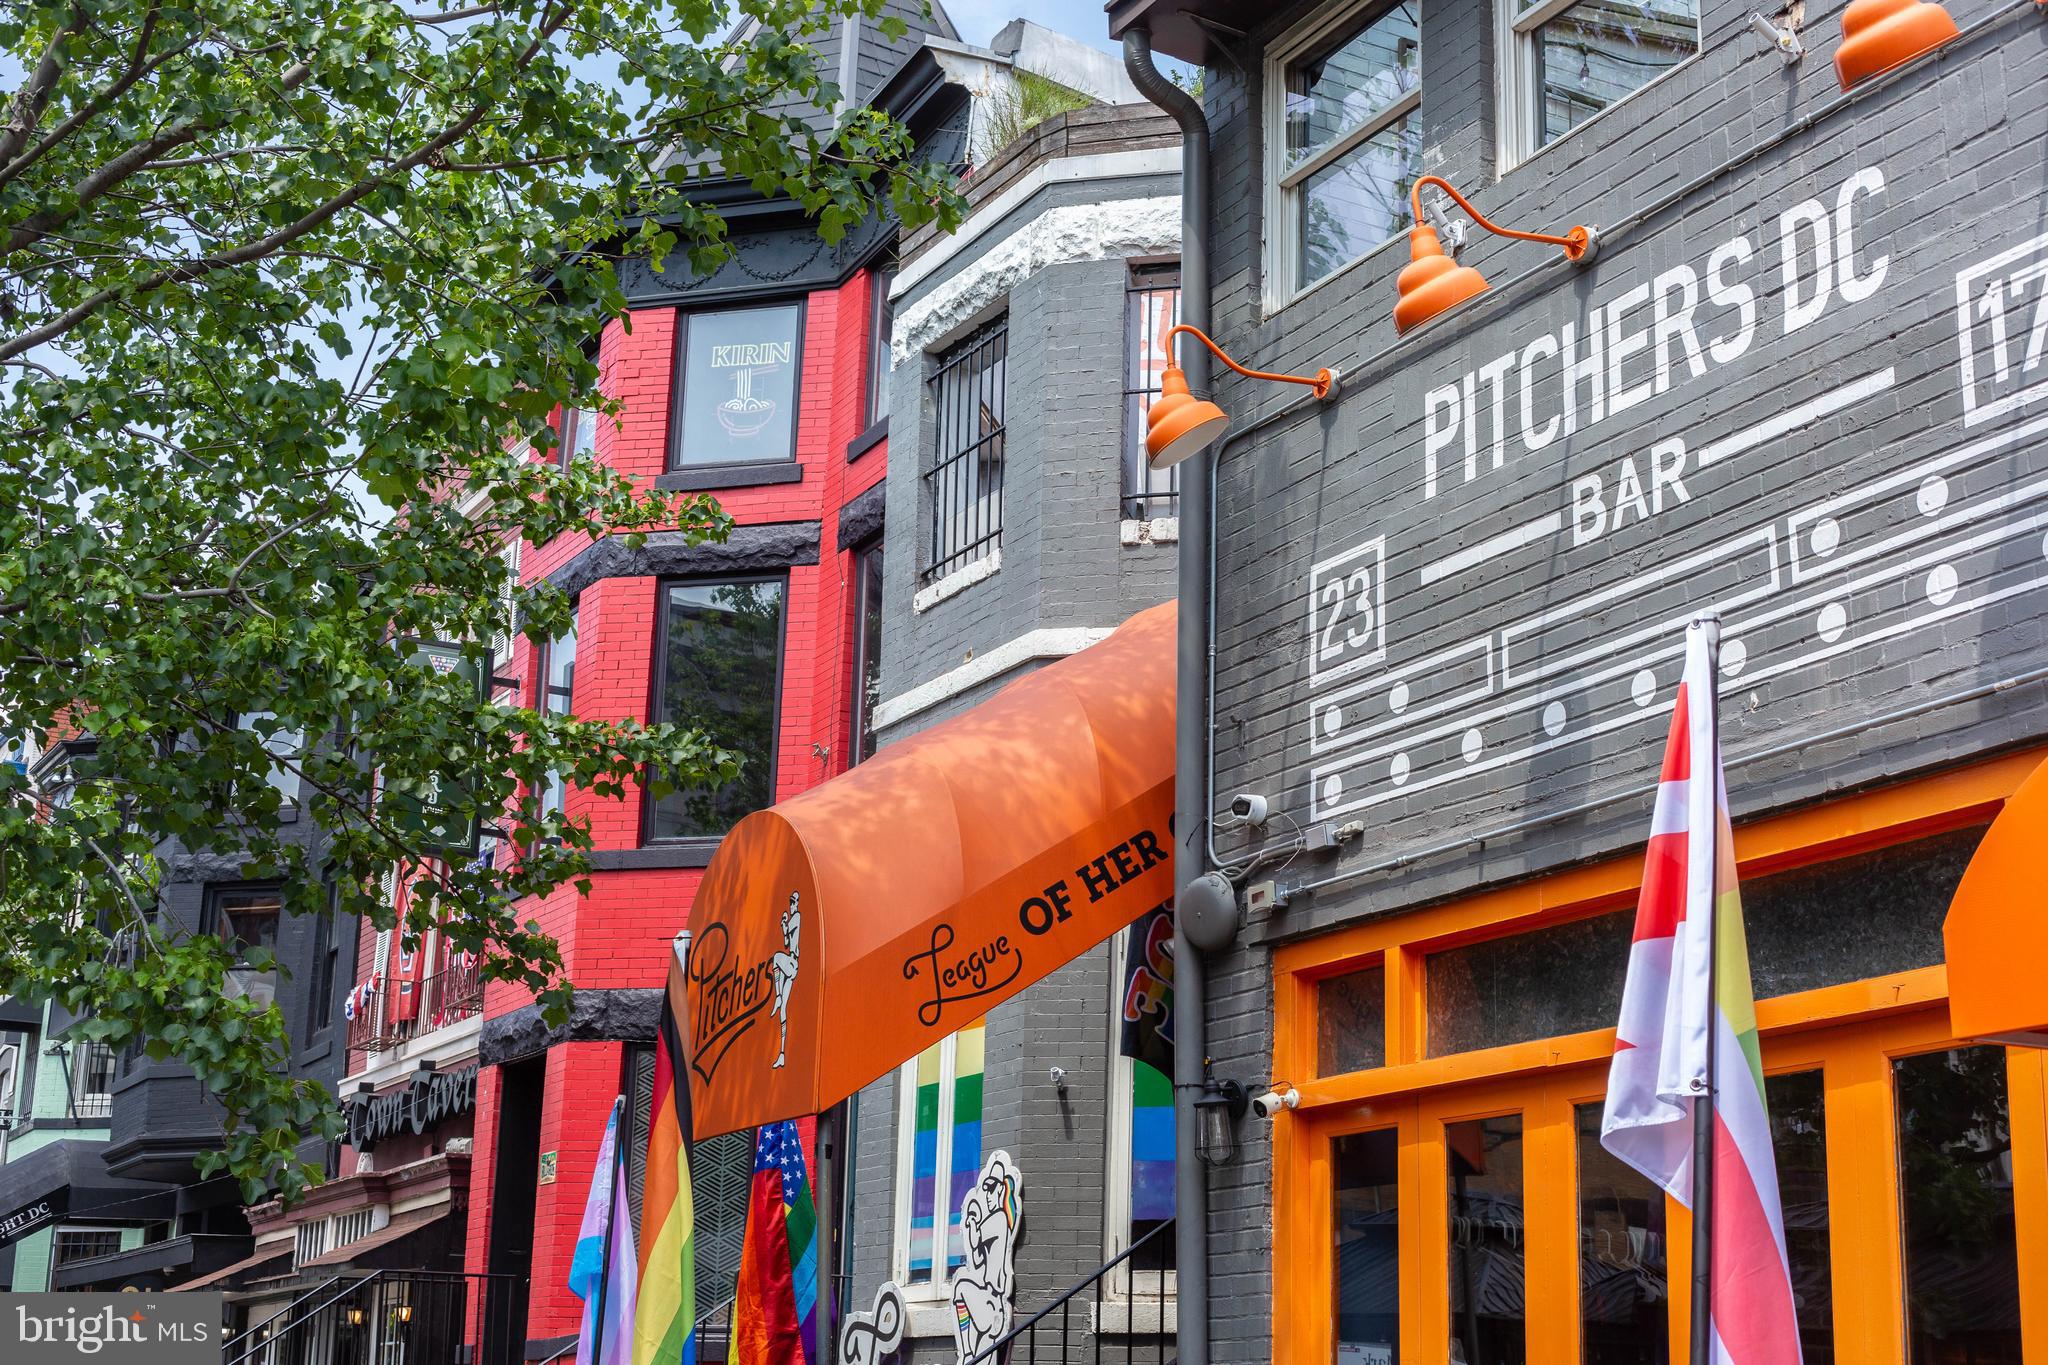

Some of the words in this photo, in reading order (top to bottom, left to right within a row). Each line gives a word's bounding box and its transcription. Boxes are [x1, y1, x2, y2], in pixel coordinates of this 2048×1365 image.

[711, 341, 791, 368] KIRIN
[1424, 237, 1757, 501] PITCHERS
[1780, 166, 1890, 335] DC
[1572, 436, 1691, 547] BAR
[1319, 566, 1374, 662] 23
[917, 923, 1023, 1027] League
[1019, 880, 1073, 936] OF
[1075, 829, 1169, 904] HER
[690, 921, 776, 1052] Pitchers
[350, 1091, 404, 1153] Town
[408, 1069, 480, 1136] Taver
[27, 1202, 50, 1220] DC
